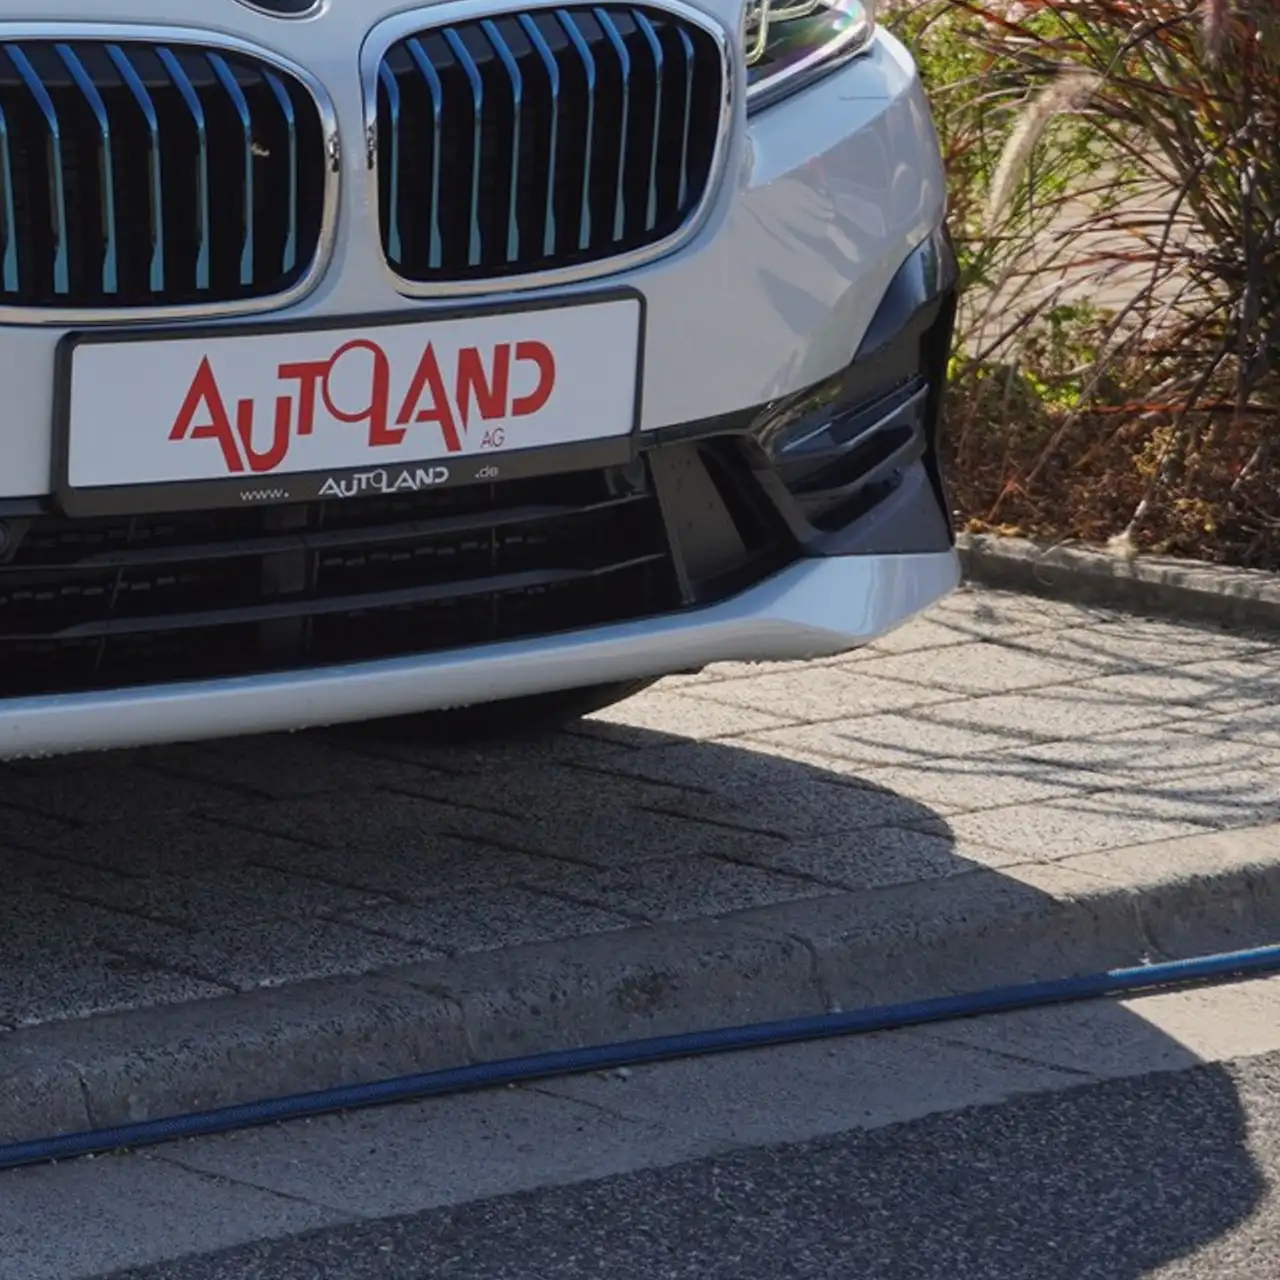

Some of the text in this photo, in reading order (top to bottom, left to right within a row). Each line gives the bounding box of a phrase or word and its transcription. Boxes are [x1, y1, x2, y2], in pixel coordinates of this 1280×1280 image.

[168, 338, 555, 473] AUTOLAND
[479, 427, 506, 450] AG
[317, 466, 450, 498] AUTOLAND
[474, 464, 499, 480] .de
